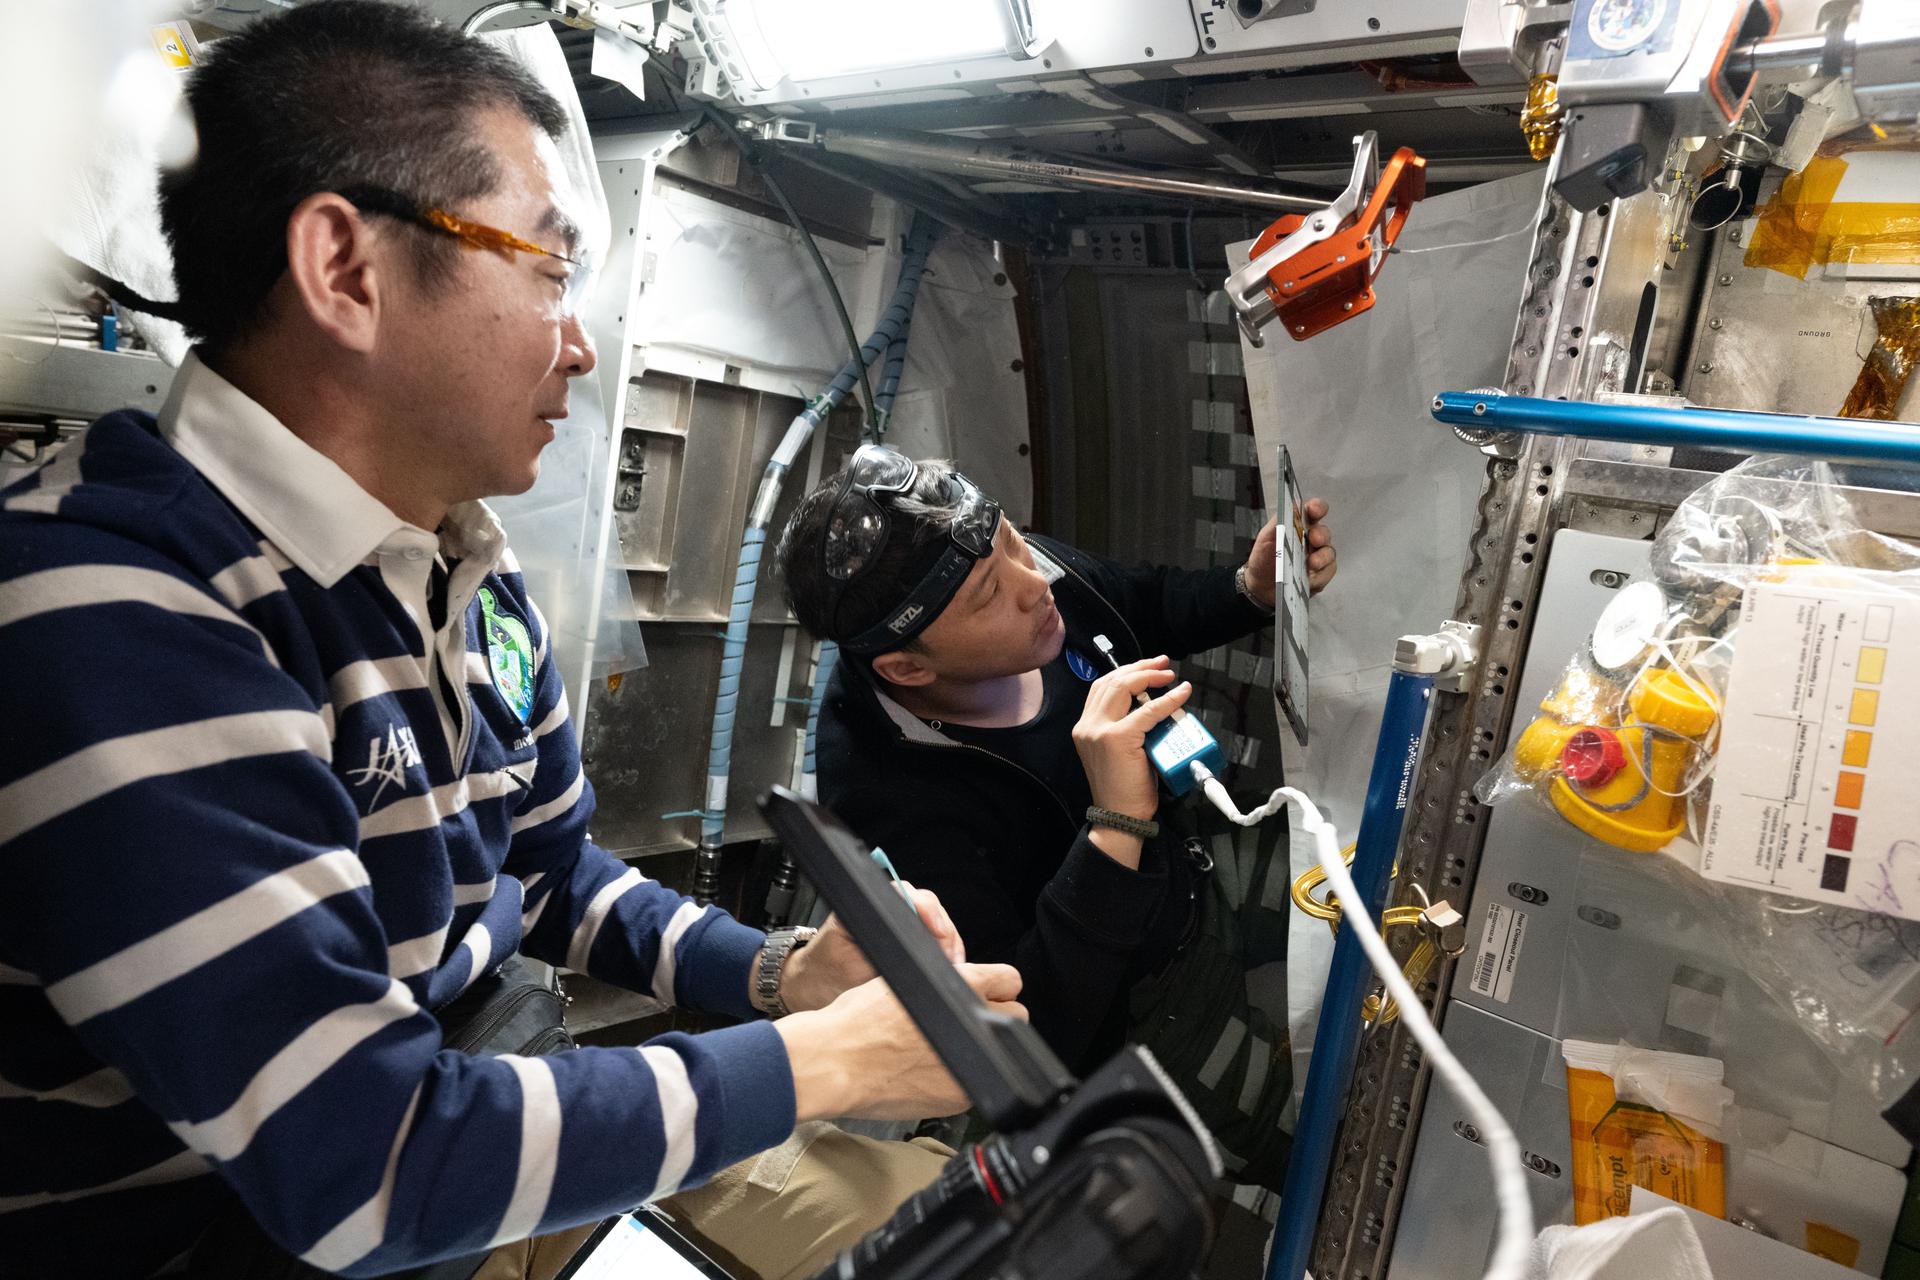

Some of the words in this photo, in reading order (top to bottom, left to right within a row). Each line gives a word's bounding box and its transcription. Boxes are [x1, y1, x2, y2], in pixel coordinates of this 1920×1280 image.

[1200, 12, 1214, 34] F
[166, 43, 178, 52] 2
[1798, 330, 1831, 338] GROUND
[1836, 612, 1845, 631] Water
[1815, 623, 1826, 654] Pre-Treat
[1808, 654, 1820, 682] Quantity
[1807, 684, 1815, 698] Low
[1799, 724, 1807, 740] Ideal
[1794, 740, 1805, 771] Pre-Treat
[1788, 772, 1800, 800] Quantity
[1781, 822, 1790, 838] Pure
[1776, 839, 1787, 869] Pre-Treat
[1796, 832, 1807, 863] Pre-Treat
[1516, 913, 1525, 927] Rear
[1510, 928, 1521, 954] Closeout
[1505, 955, 1515, 972] Panel
